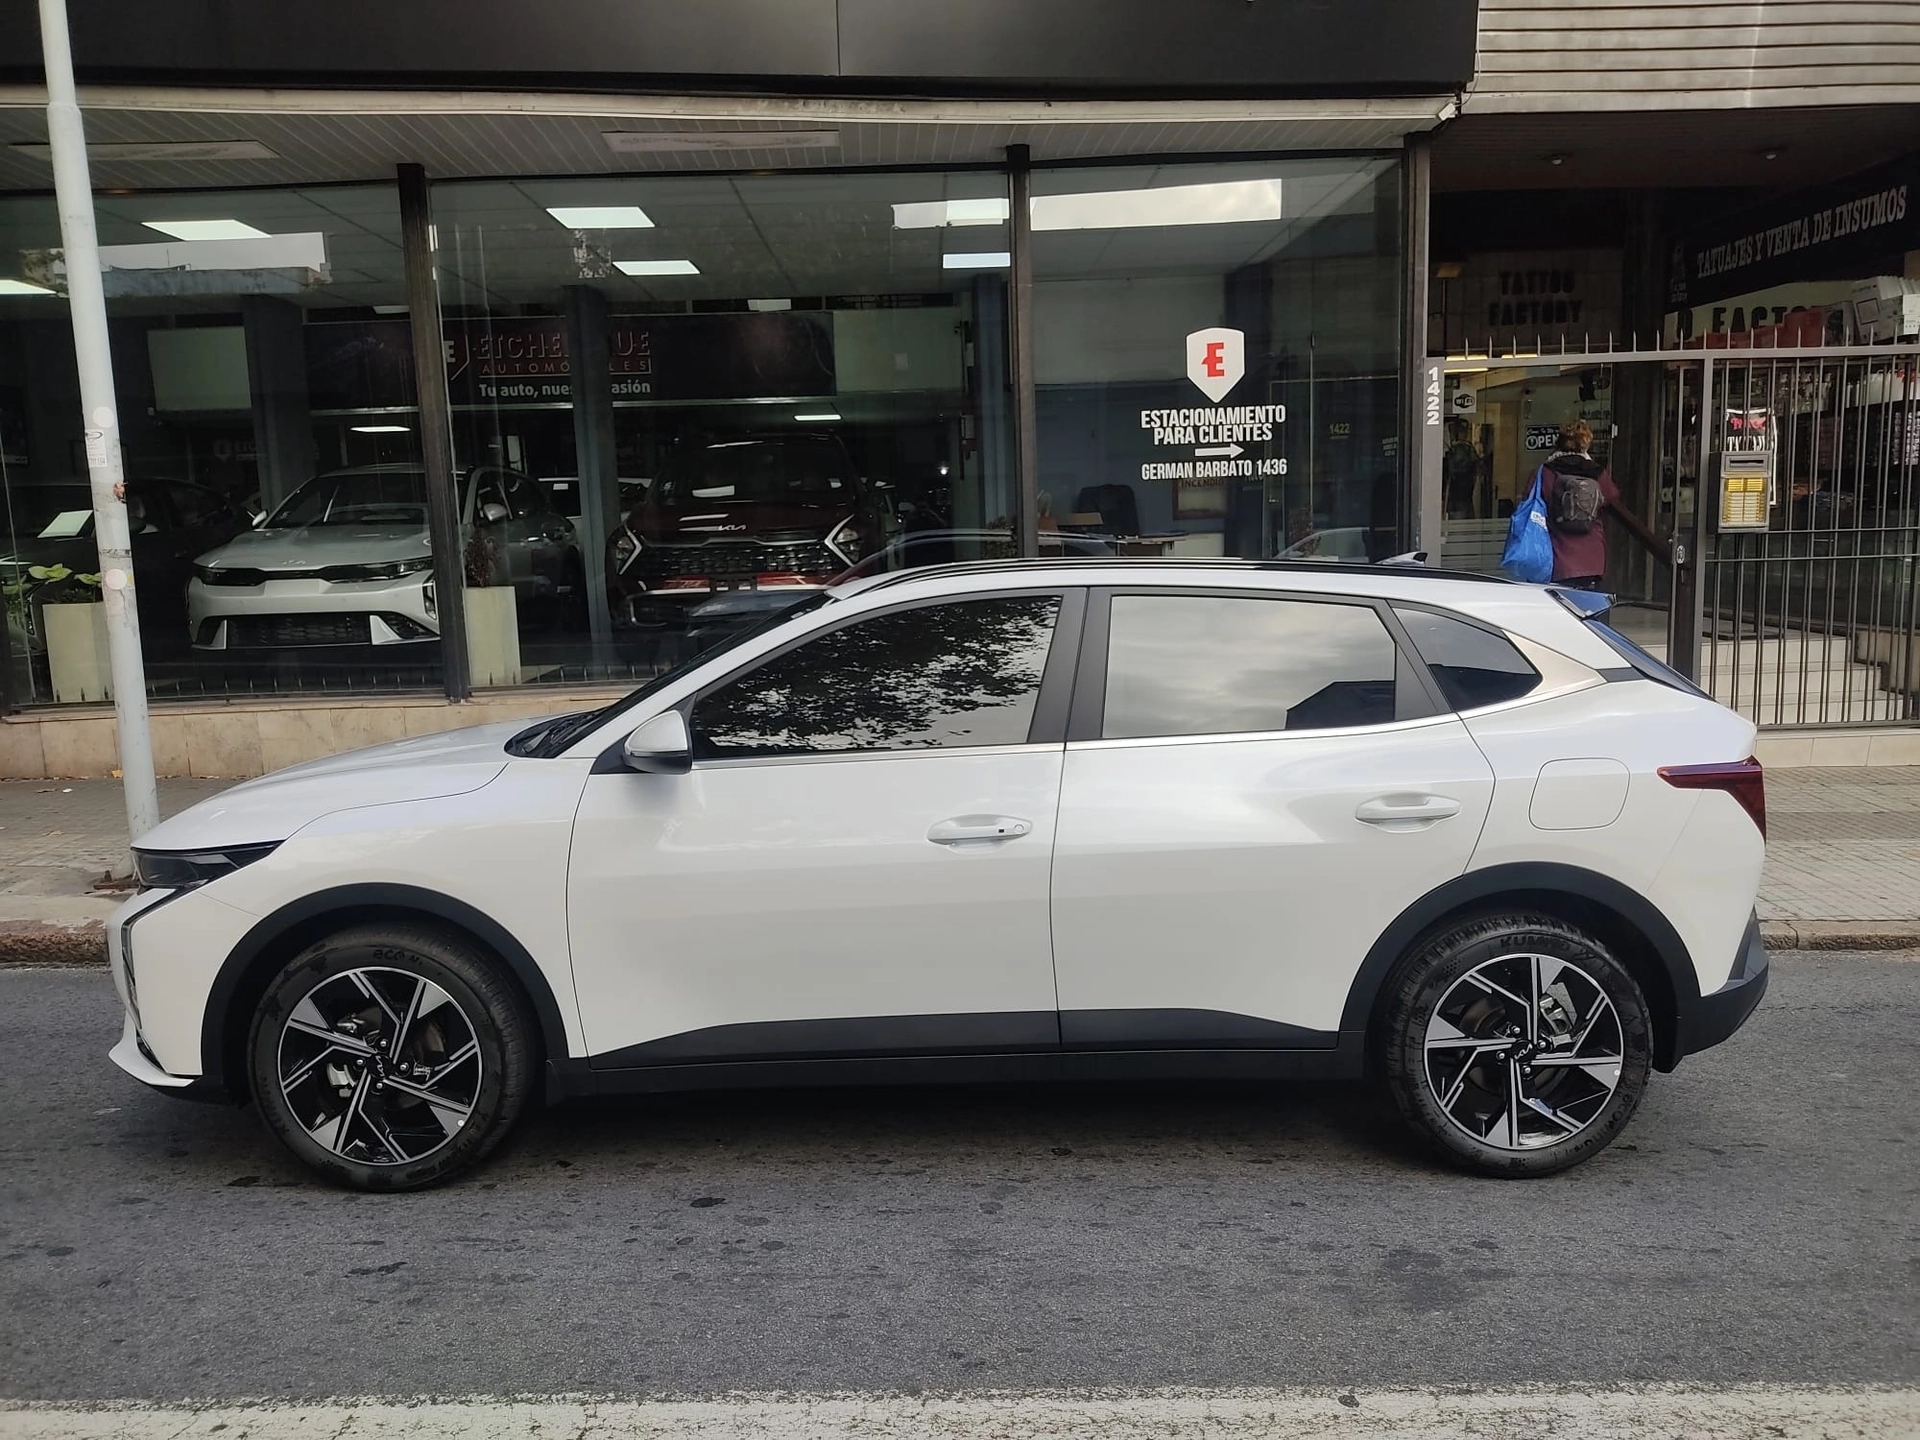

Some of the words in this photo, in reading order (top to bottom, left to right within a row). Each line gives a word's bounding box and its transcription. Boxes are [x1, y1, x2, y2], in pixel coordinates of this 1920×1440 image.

[1697, 235, 1754, 279] TATUAJES
[1755, 230, 1766, 261] Y
[1766, 217, 1810, 259] VENTA
[1812, 208, 1832, 245] DE
[1834, 185, 1908, 239] INSUMOS
[1201, 342, 1225, 378] E
[479, 384, 497, 397] Tu
[500, 384, 539, 399] auto,
[1427, 366, 1440, 426] 1422
[1141, 405, 1287, 429] ESTACIONAMIENTO
[1329, 423, 1350, 434] 1422
[1153, 426, 1196, 445] PARA
[1199, 423, 1273, 443] CLIENTES
[1526, 433, 1560, 450] OPEN
[1141, 462, 1194, 481] GERMAN
[1195, 460, 1253, 478] BARBATO
[1256, 458, 1288, 476] 1436
